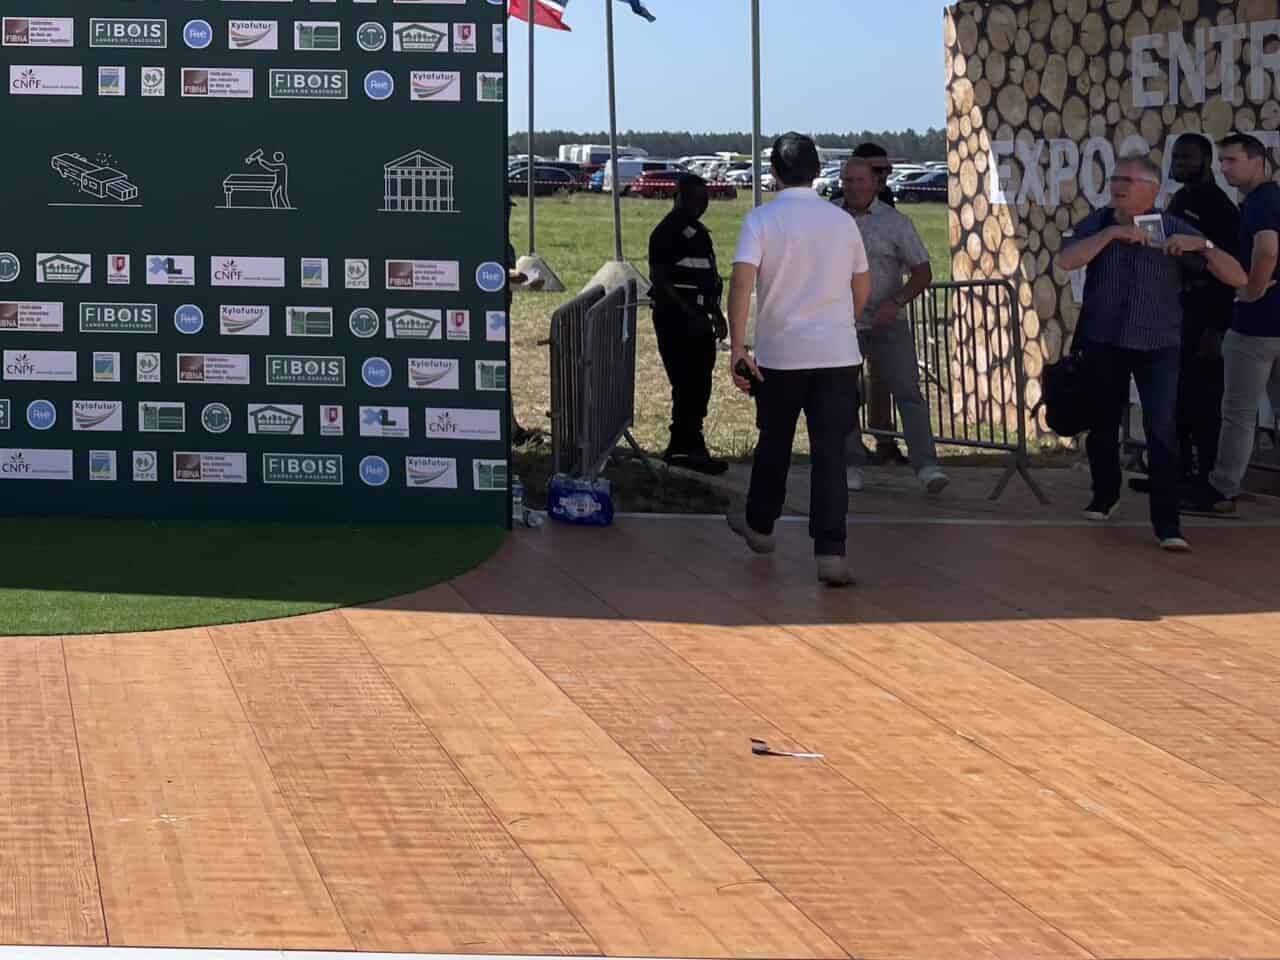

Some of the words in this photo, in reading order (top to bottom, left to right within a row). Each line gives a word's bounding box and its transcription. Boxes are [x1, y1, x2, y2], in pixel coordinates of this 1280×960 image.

[95, 23, 161, 37] FIBOIS
[231, 22, 272, 30] Xylofutur
[1132, 19, 1280, 108] ENTR
[275, 74, 342, 88] FIBOIS
[412, 73, 454, 81] Xylofutur
[13, 79, 42, 88] CNPF
[214, 271, 243, 280] CNPF
[86, 308, 152, 322] FIBOIS
[222, 307, 263, 315] Xylofutur
[272, 360, 339, 375] FIBOIS
[410, 360, 453, 368] Xylofutur
[6, 365, 35, 374] CNPF
[74, 402, 116, 410] Xylofutur
[428, 423, 458, 433] CNPF
[270, 458, 337, 473] FIBOIS
[408, 458, 451, 466] Xylofutur
[2, 463, 31, 473] CNPF
